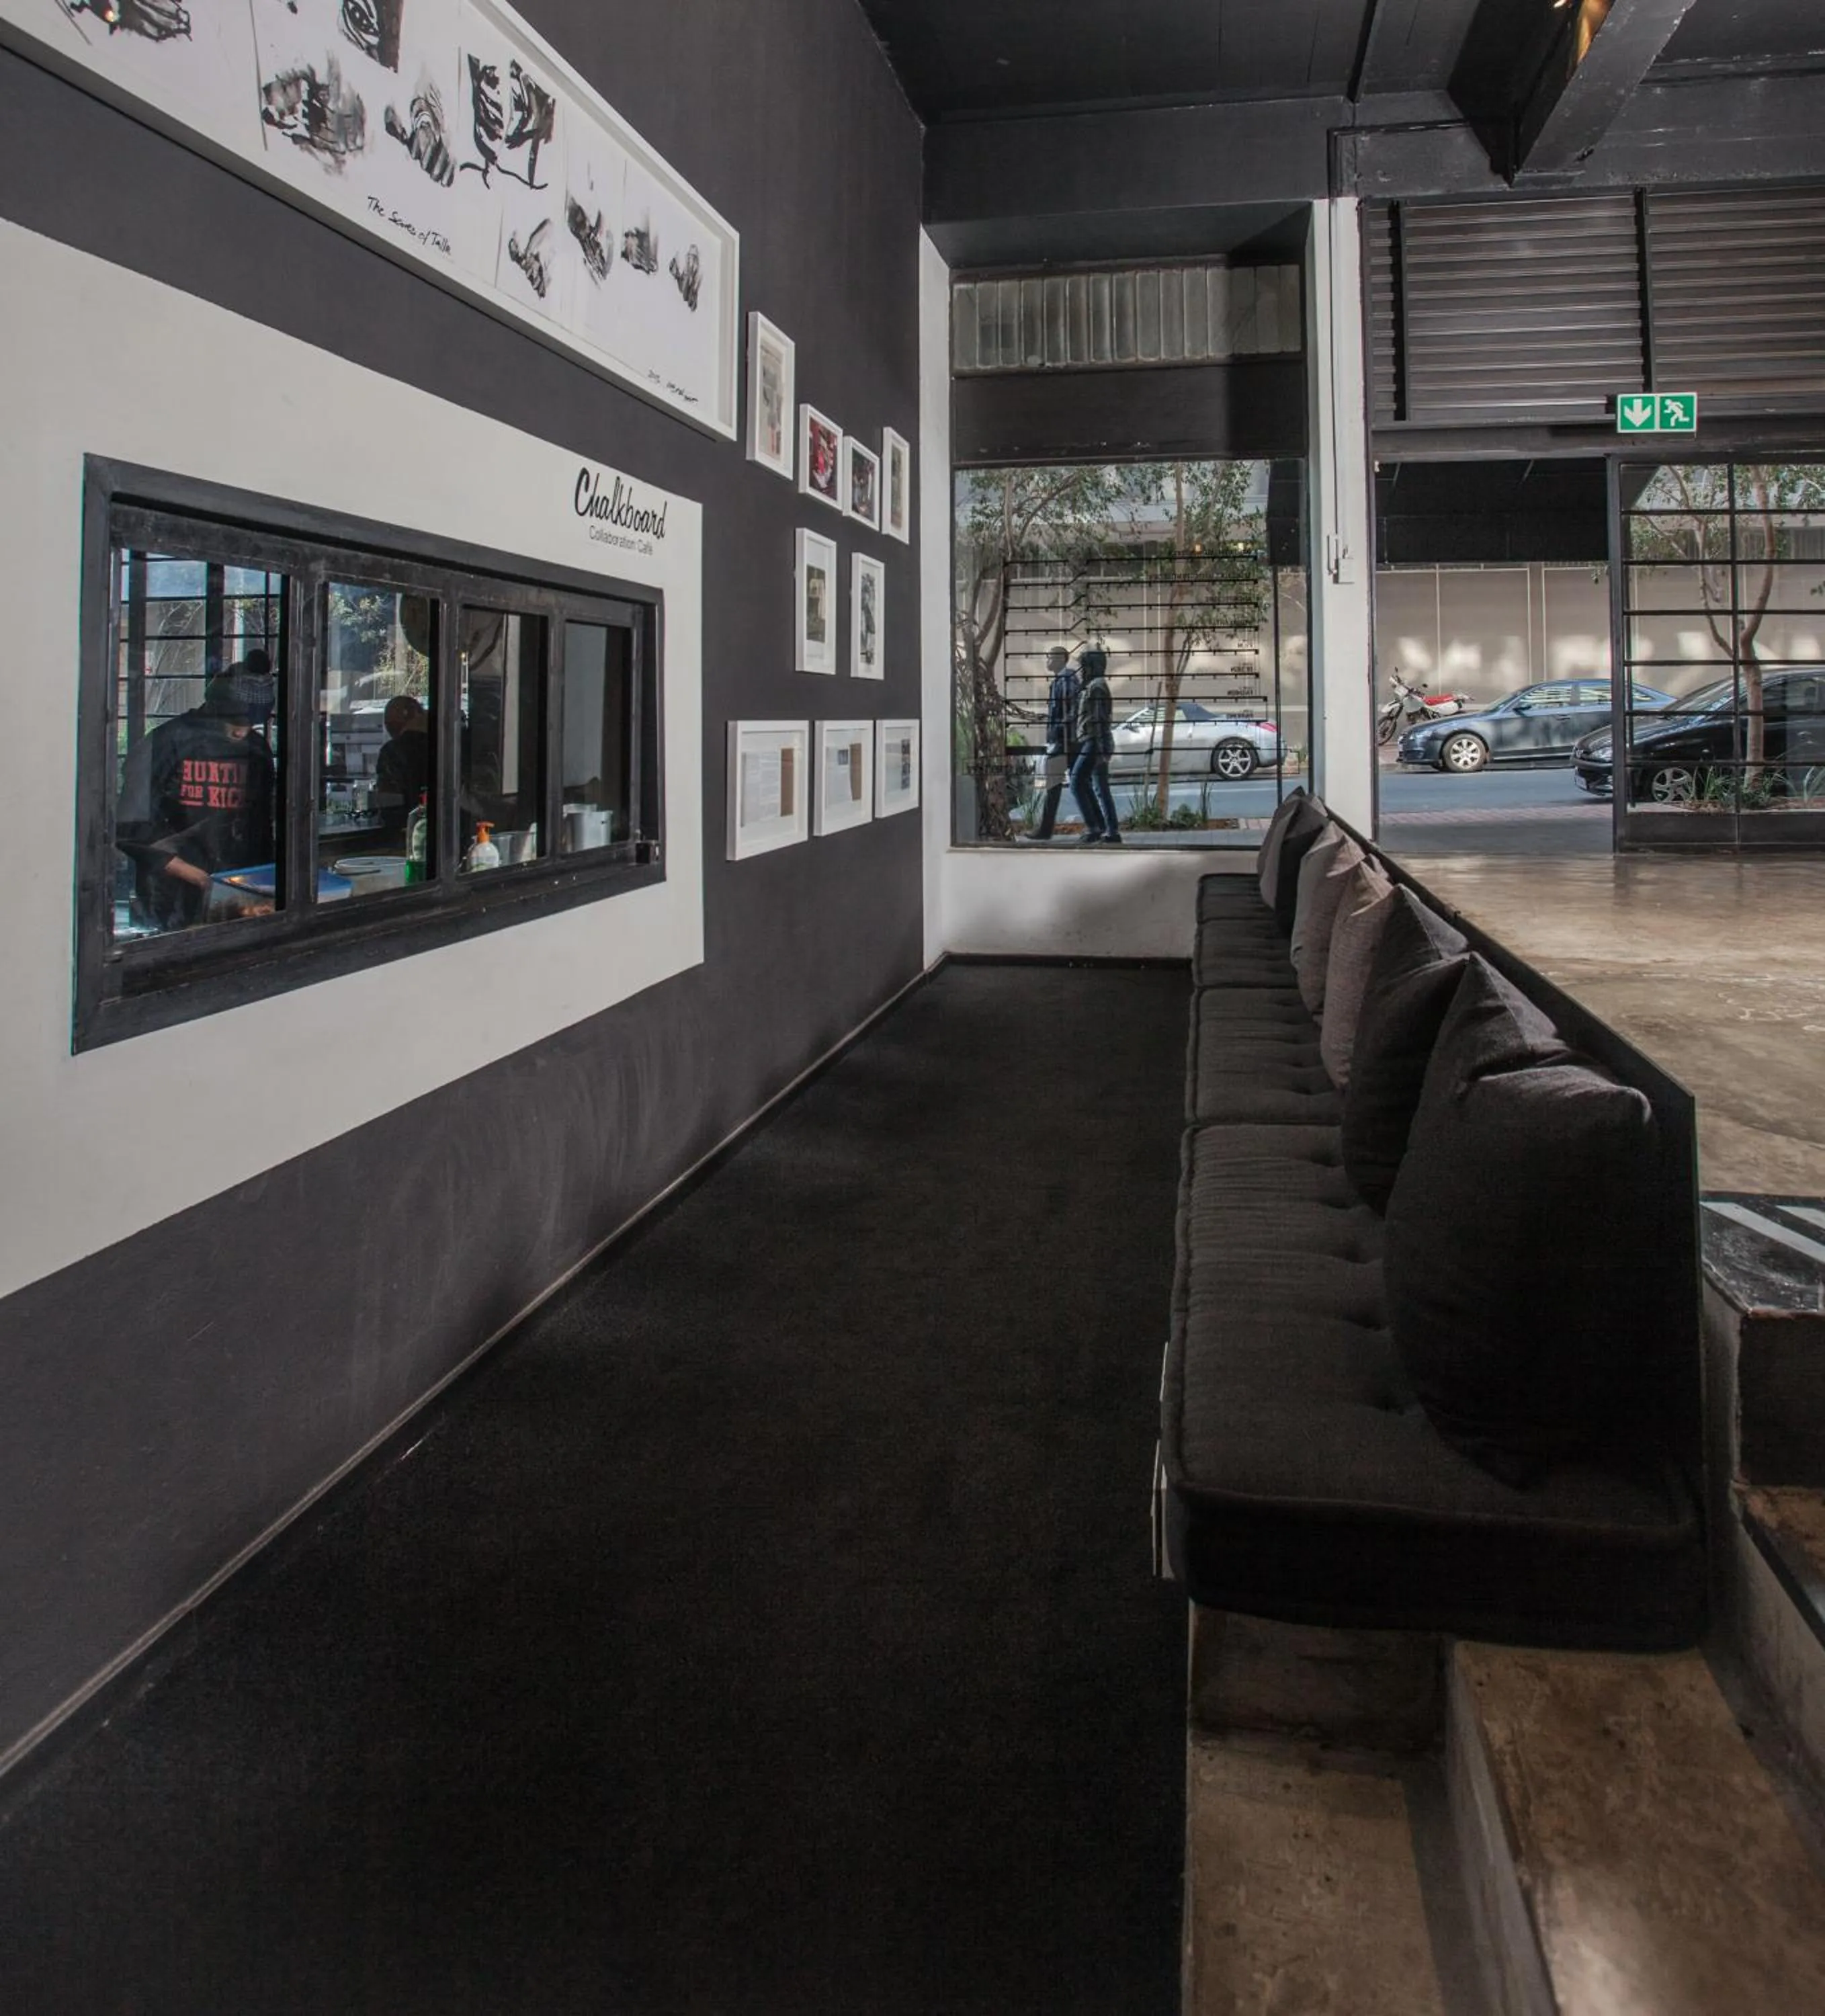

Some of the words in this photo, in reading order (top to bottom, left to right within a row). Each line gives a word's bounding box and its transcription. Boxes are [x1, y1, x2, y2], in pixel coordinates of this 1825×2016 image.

[367, 196, 386, 217] The
[575, 467, 667, 540] Chalkboard
[589, 524, 637, 550] Collaboration
[206, 786, 245, 808] KIC
